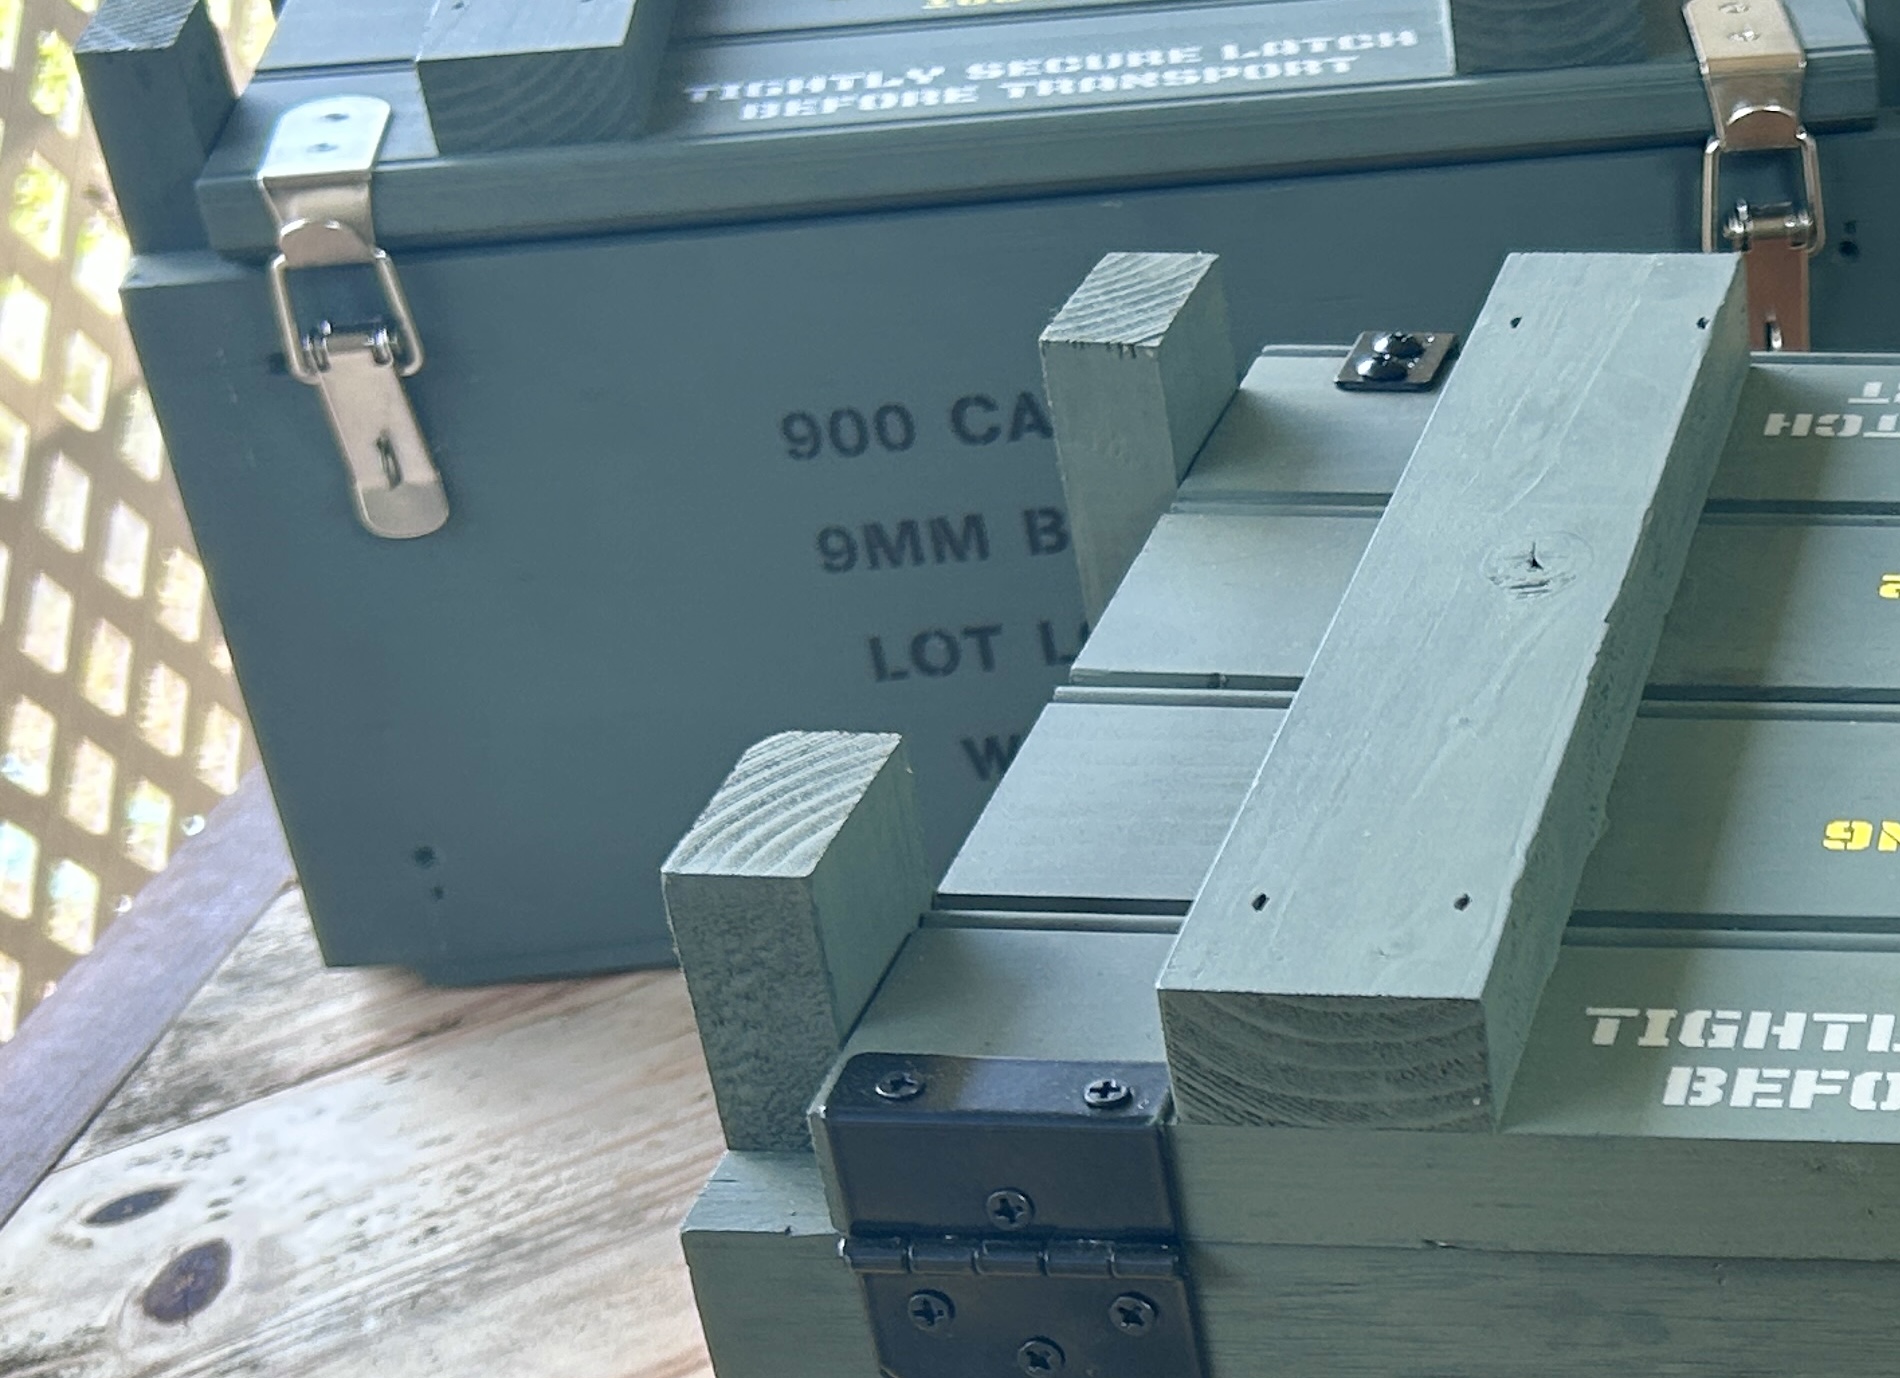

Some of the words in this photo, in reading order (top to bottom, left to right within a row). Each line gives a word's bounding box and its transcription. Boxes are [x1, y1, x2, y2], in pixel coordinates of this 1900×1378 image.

[683, 66, 946, 103] TIGHTLY
[964, 47, 1203, 81] SECURE
[1220, 29, 1419, 61] LATCH
[737, 84, 982, 121] BEFORE
[997, 56, 1360, 99] TRANSPORT
[781, 404, 917, 461] 900
[815, 513, 991, 574] 9MM
[867, 624, 1003, 683] LOT
